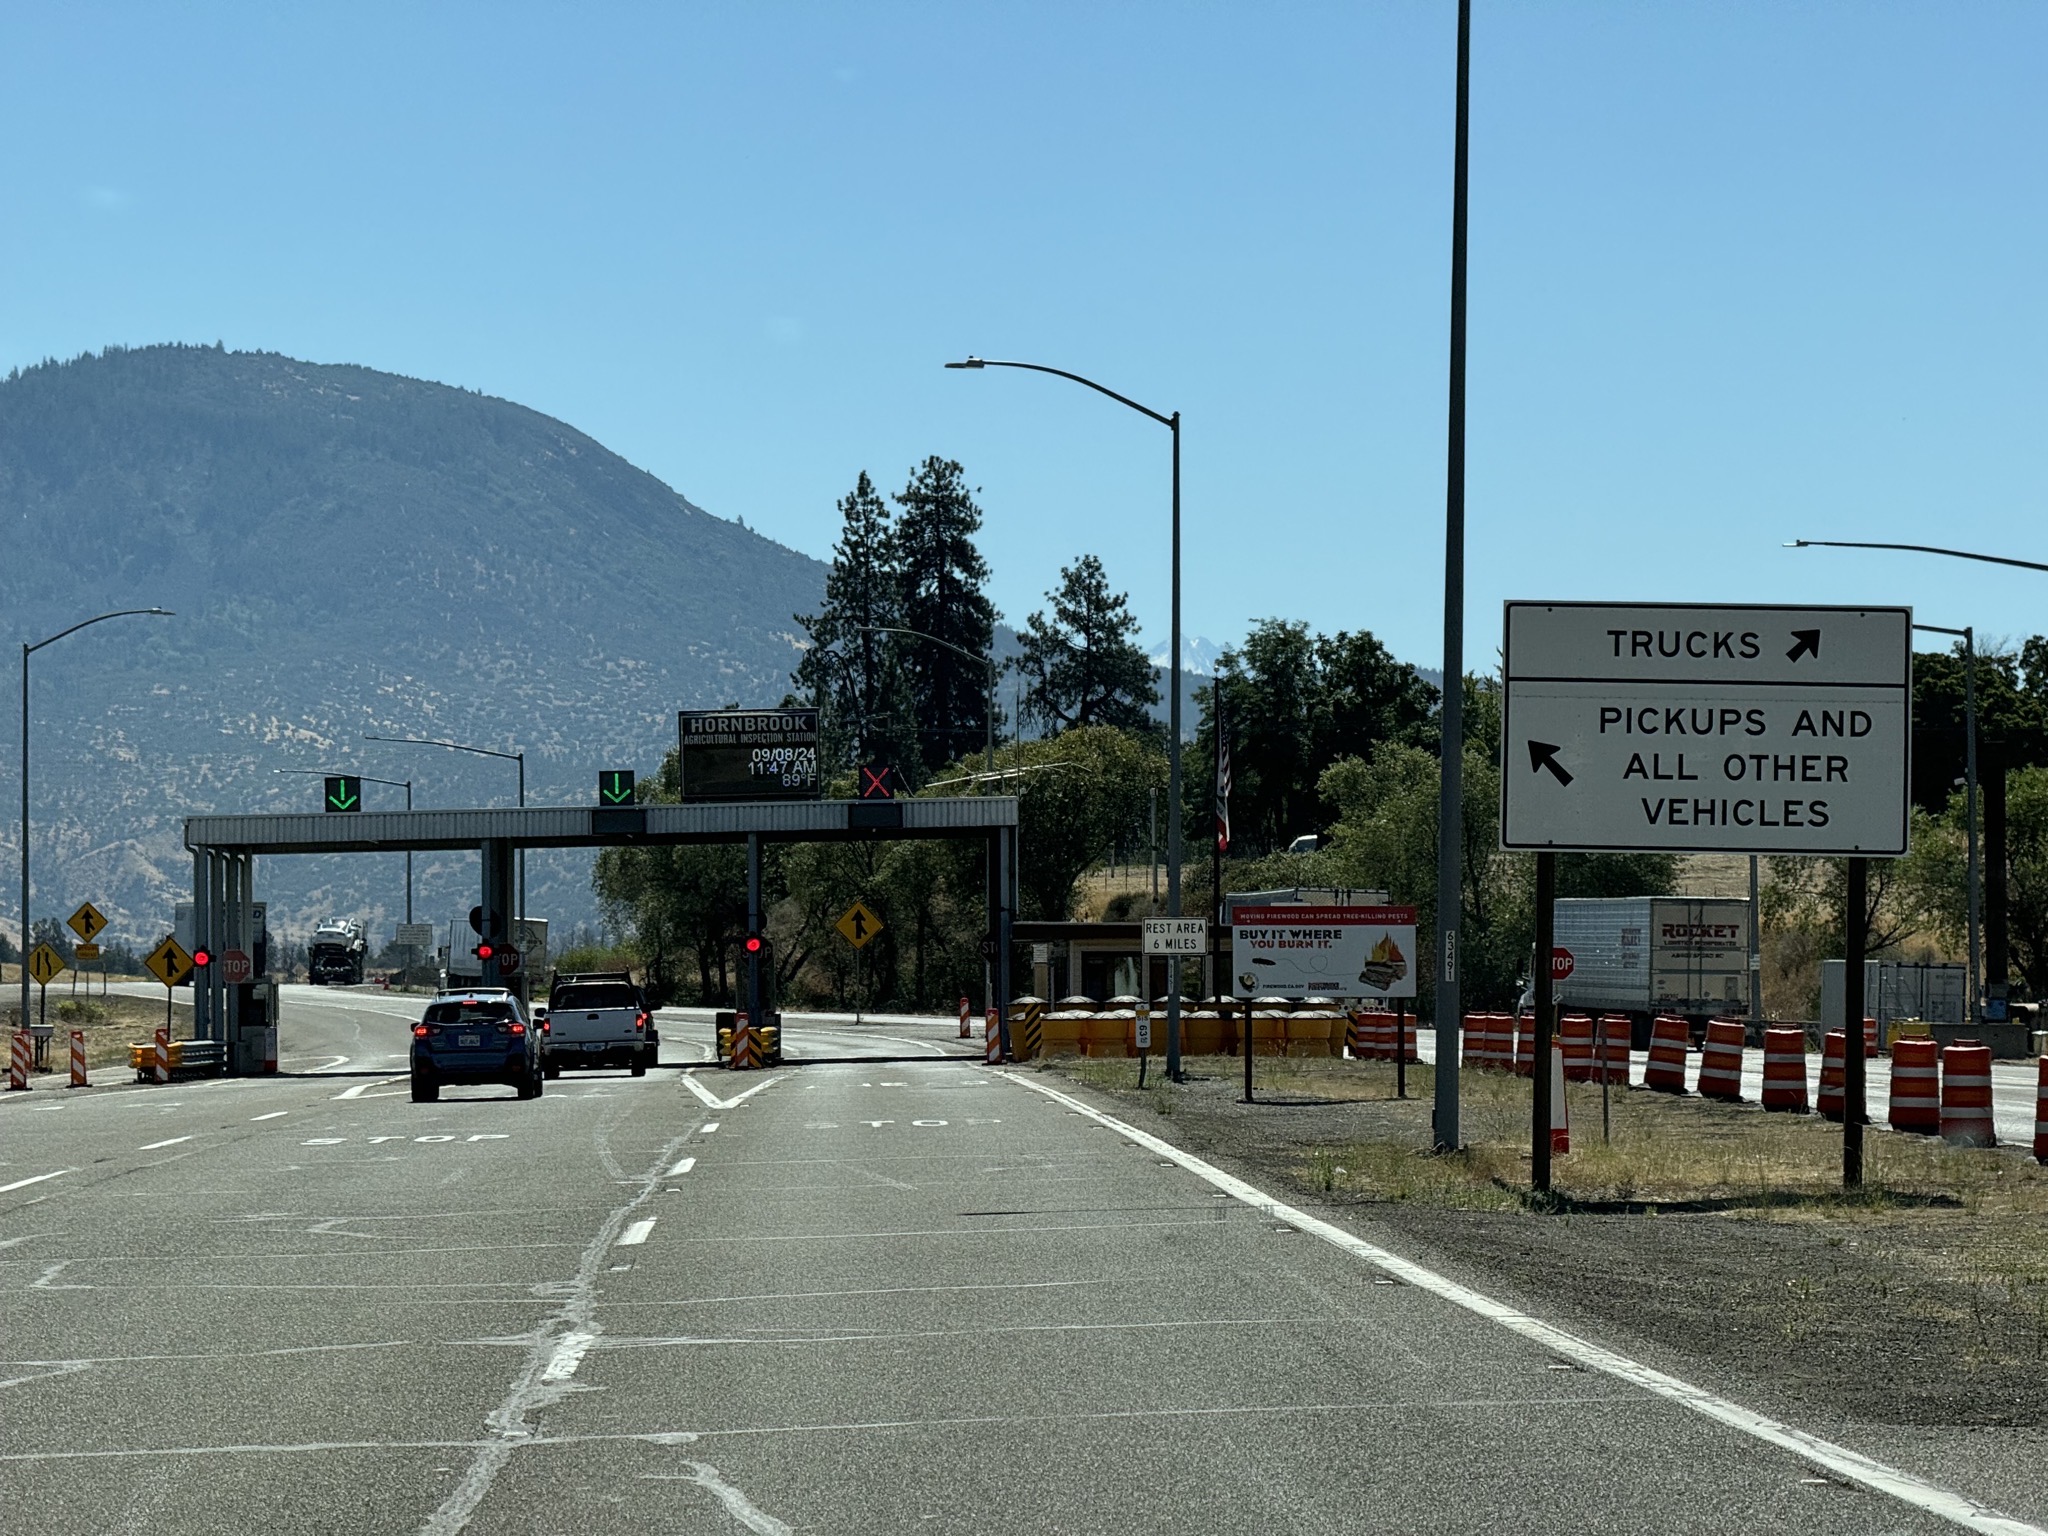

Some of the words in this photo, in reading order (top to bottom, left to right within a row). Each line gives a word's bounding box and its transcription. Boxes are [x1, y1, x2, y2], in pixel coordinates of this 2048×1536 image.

[1606, 629, 1761, 660] TRUCKS
[691, 716, 808, 733] HORNBROOK
[1599, 706, 1767, 736] PICKUPS
[1791, 710, 1872, 738] AND
[684, 734, 737, 745] AGRICULTURAL
[740, 732, 783, 744] INSPECTION
[786, 732, 817, 743] STATION
[752, 747, 816, 762] 09/08/24
[748, 761, 788, 775] 11:47
[792, 760, 817, 774] AM
[1622, 752, 1699, 781] ALL
[1723, 753, 1849, 783] OTHER
[1641, 797, 1830, 828] VEHICLES
[1146, 923, 1171, 934] REST
[1176, 923, 1204, 934] AREA
[1239, 929, 1269, 940] BUY
[1271, 929, 1286, 940] IT
[1288, 929, 1342, 940] WHERE
[1662, 923, 1740, 939] ROCKET
[982, 941, 998, 954] ST
[1153, 938, 1160, 949] 6
[1165, 938, 1197, 950] MILES
[1250, 940, 1275, 949] YOU
[1278, 940, 1314, 949] BURN
[1317, 940, 1333, 949] IT.
[742, 946, 772, 959] SP
[1446, 931, 1454, 980] 63491
[1552, 957, 1573, 971] TOP
[300, 1134, 510, 1146] STOP
